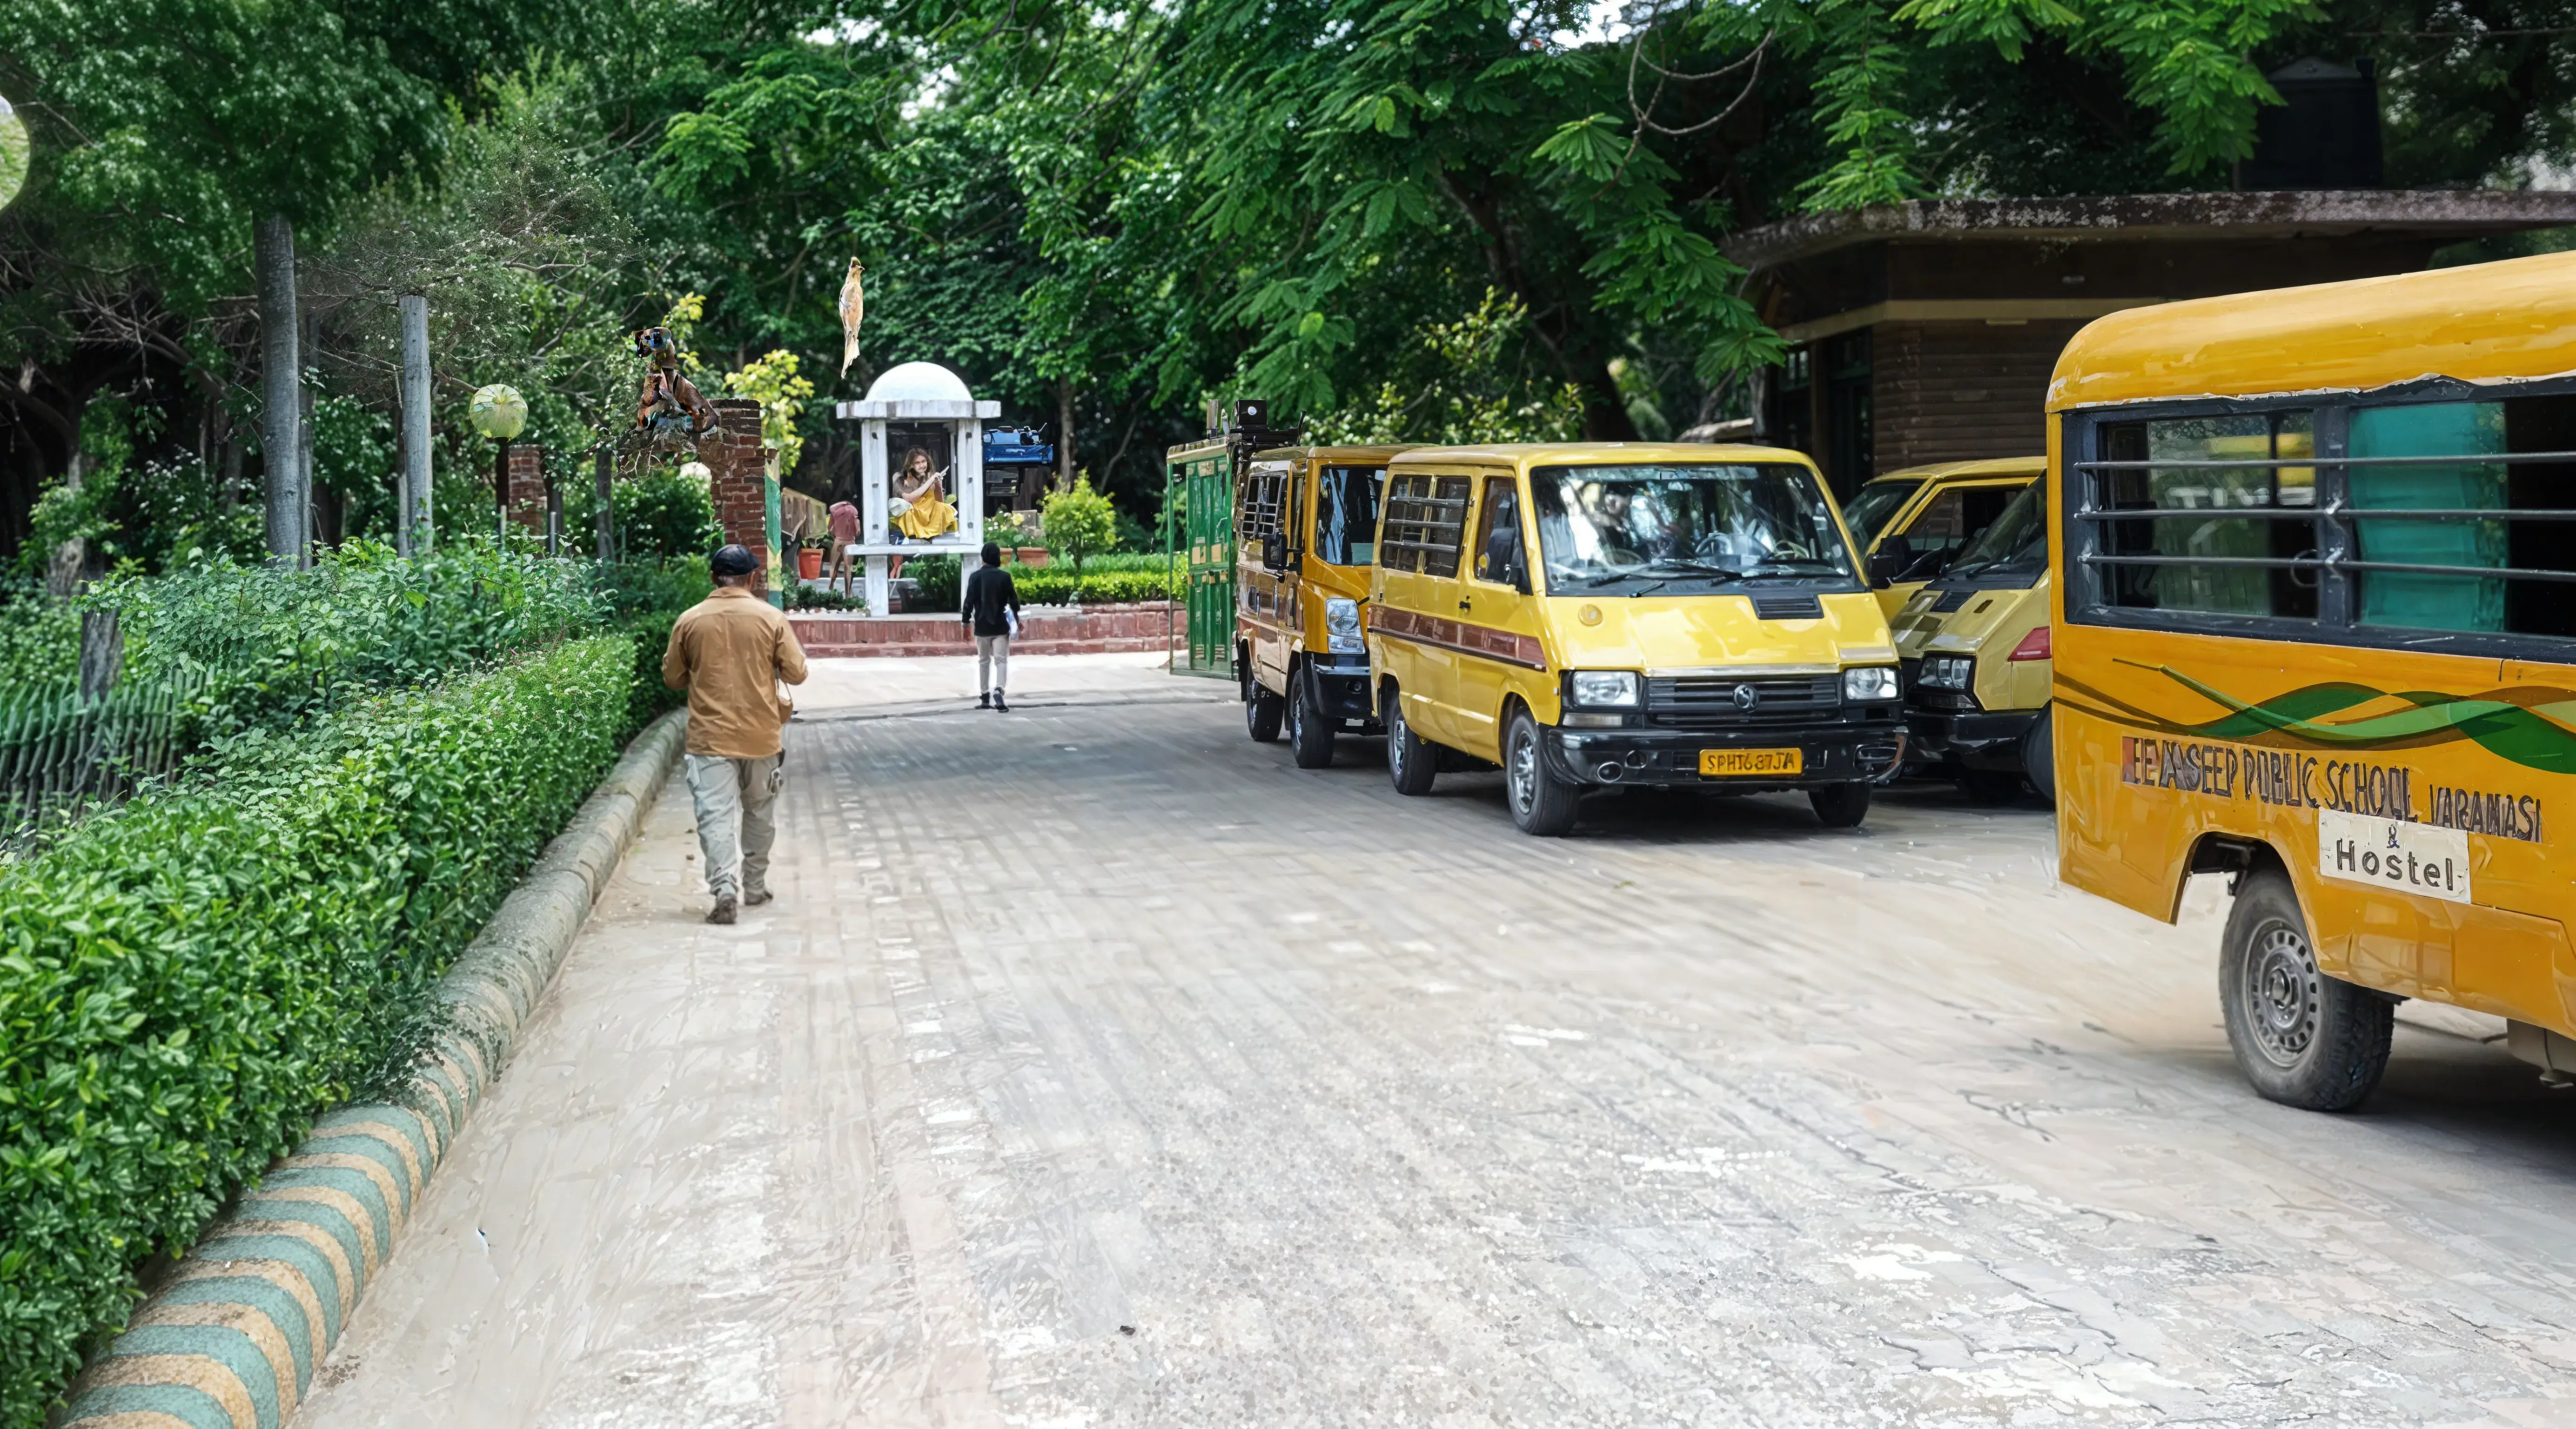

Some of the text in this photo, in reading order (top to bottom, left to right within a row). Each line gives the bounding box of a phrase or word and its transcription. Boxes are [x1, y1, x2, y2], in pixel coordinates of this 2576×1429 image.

[2243, 748, 2320, 808] PUBLIC
[2324, 760, 2418, 822] SCHOOL
[2336, 838, 2454, 891] Hostel
